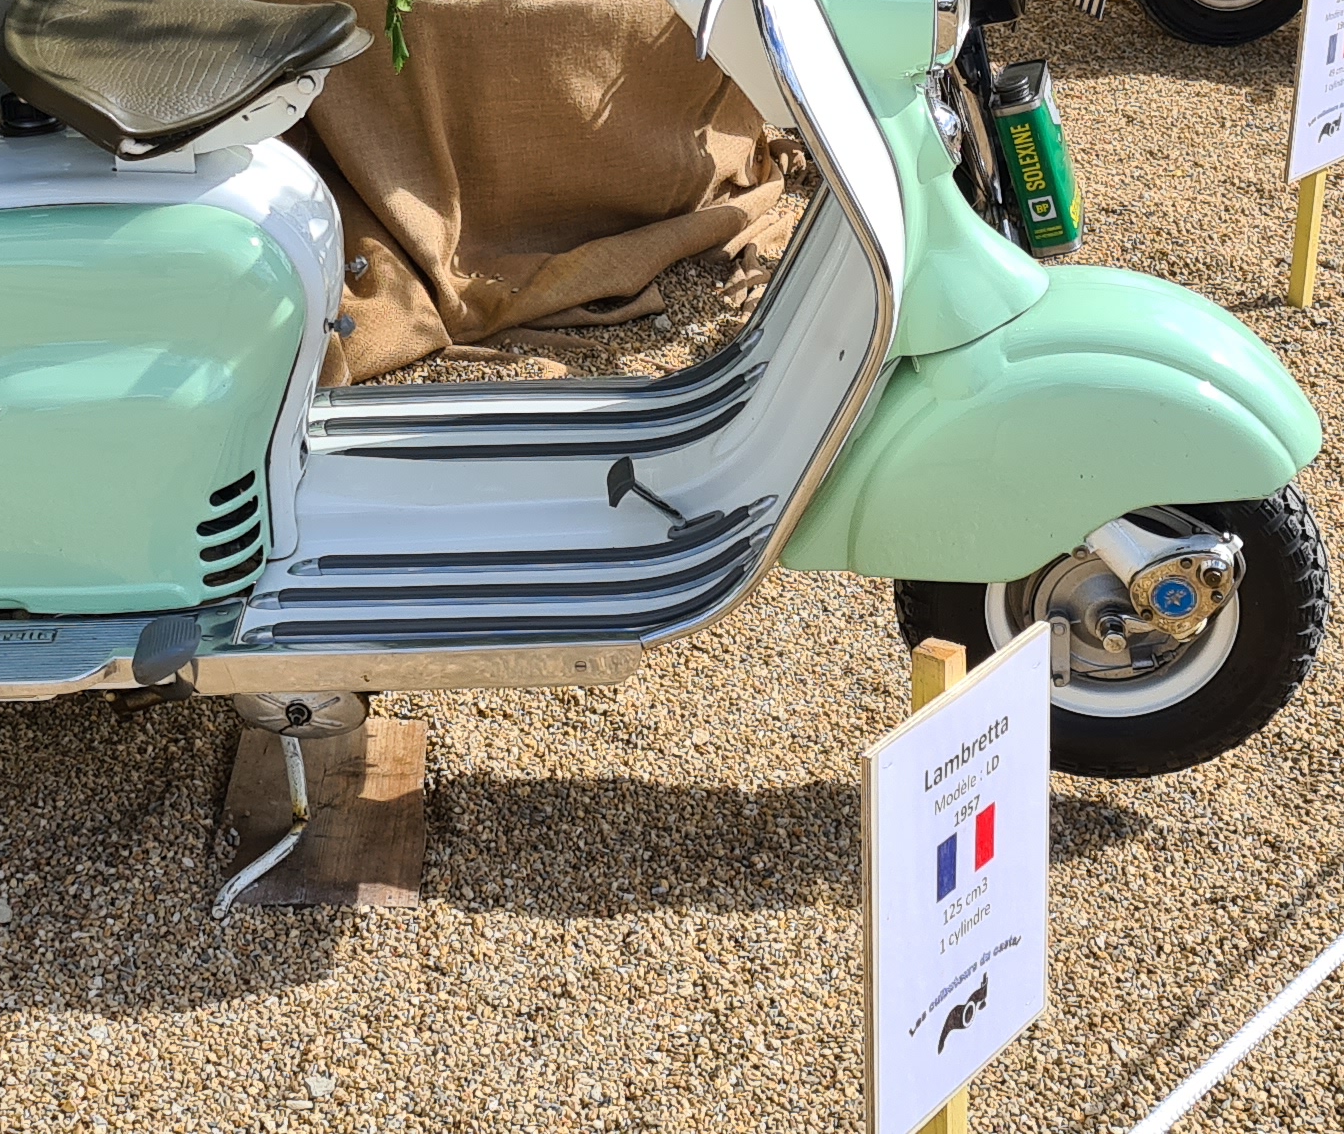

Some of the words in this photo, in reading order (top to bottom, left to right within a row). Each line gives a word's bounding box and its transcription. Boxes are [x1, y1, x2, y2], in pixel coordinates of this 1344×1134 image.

[1009, 122, 1046, 192] SOLEXINE
[1036, 203, 1049, 214] BP
[924, 715, 1009, 793] Lambretta
[934, 774, 977, 816] Modèle
[986, 754, 1000, 776] LD
[953, 794, 981, 828] 1957
[942, 896, 963, 926] 125
[965, 876, 988, 907] cm3
[939, 938, 946, 955] 1
[948, 903, 991, 947] cylindre
